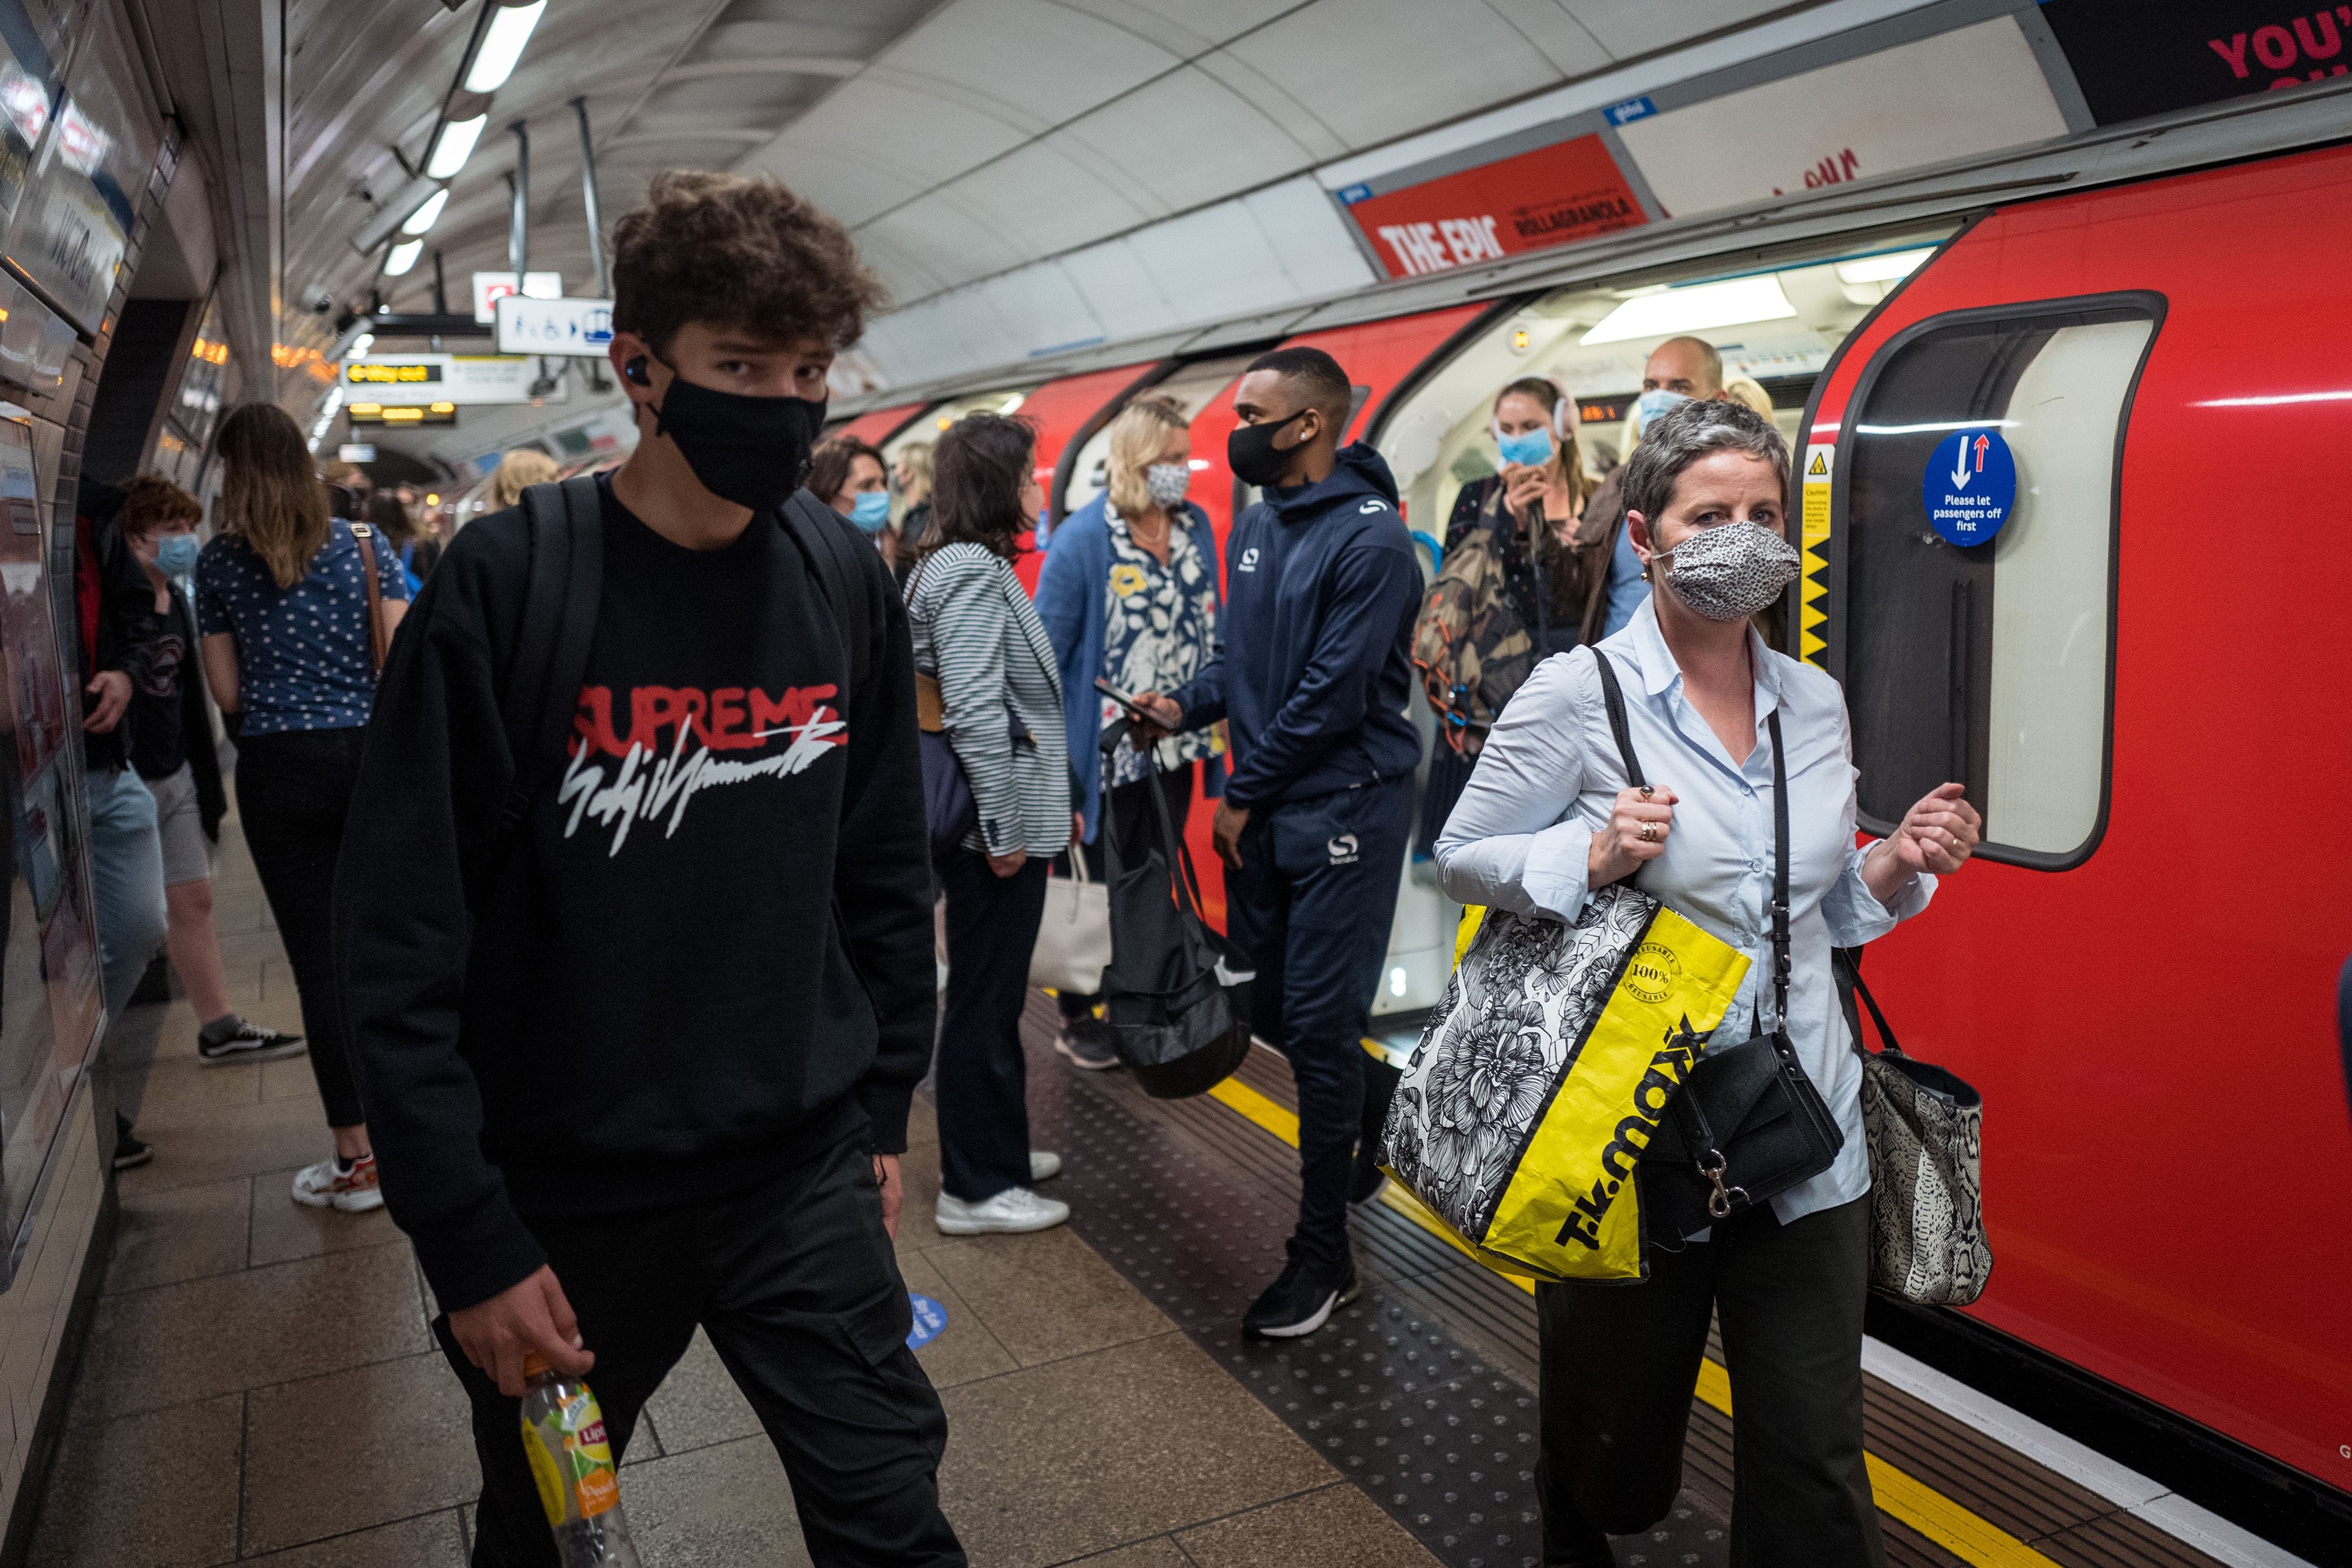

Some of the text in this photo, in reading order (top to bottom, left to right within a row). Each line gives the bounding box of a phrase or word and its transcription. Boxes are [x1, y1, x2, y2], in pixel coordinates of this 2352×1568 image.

[1378, 222, 1451, 277] THE
[1945, 494, 1991, 506] Please let
[1934, 507, 2002, 520] passengers off
[1956, 520, 1977, 531] first
[567, 683, 848, 758] SUPREME
[1636, 945, 1676, 965] REUSABLE
[1632, 963, 1669, 985] 100%
[1628, 983, 1668, 1001] REUSABLE
